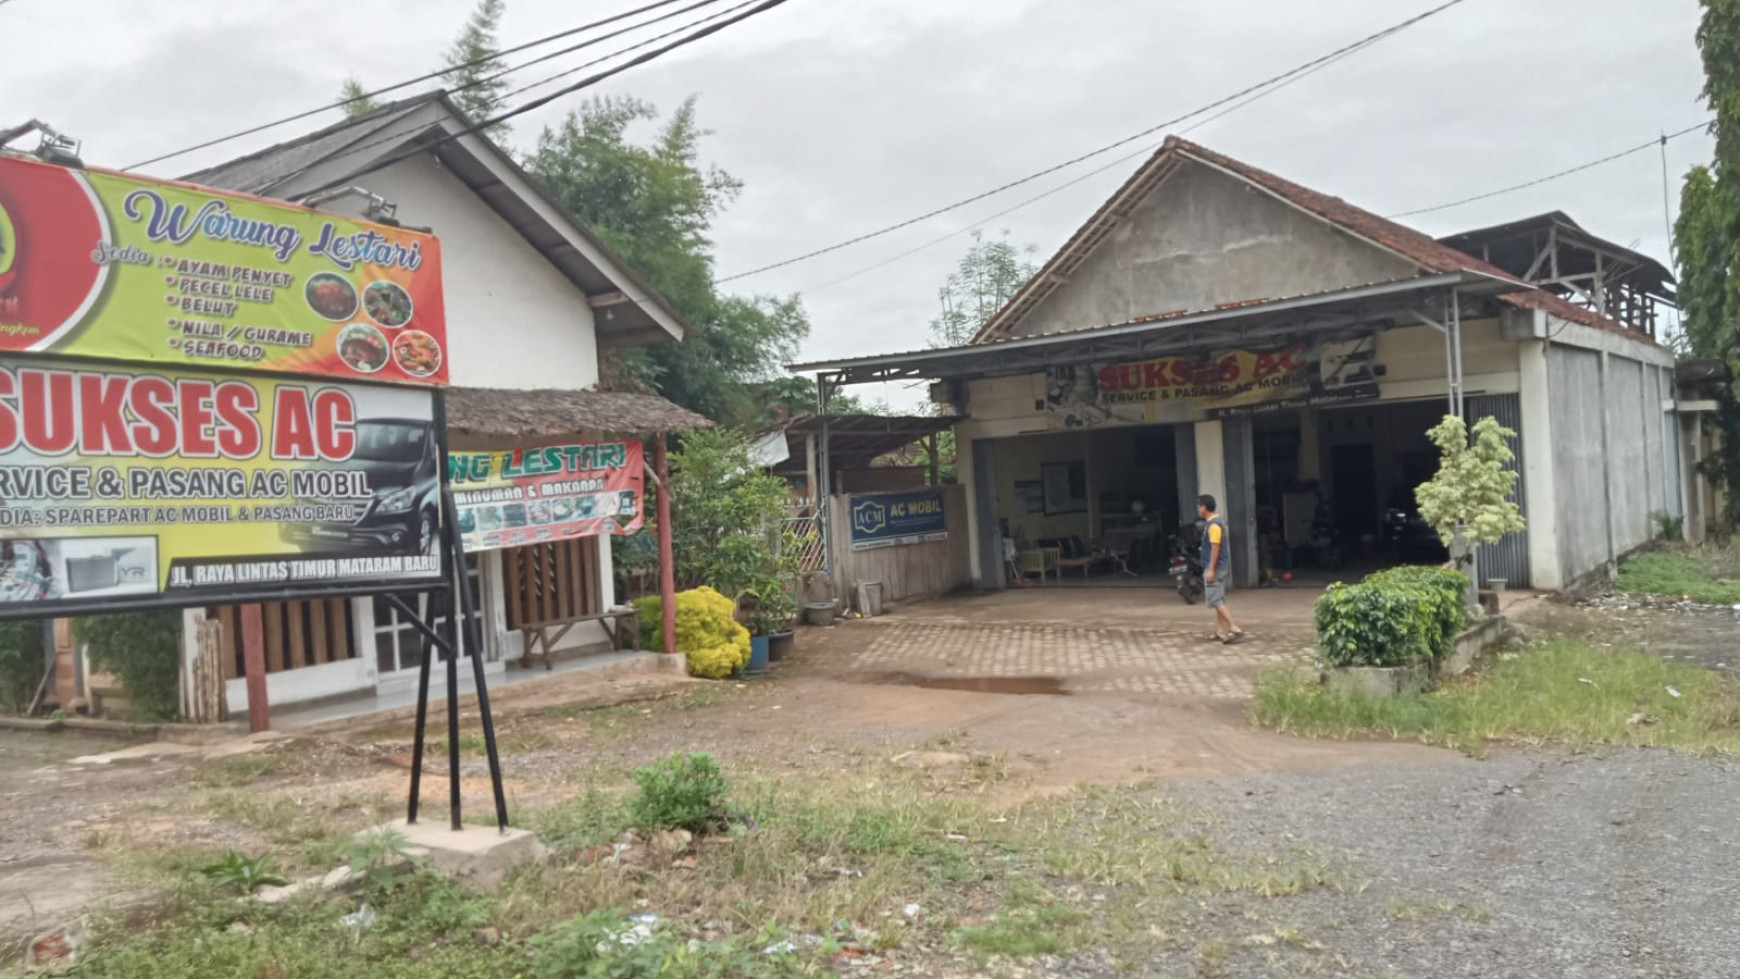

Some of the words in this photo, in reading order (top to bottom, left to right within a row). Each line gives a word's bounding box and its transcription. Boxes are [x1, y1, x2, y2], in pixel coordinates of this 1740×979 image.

[124, 188, 300, 262] Warung
[309, 222, 422, 271] Lestari
[90, 240, 151, 266] Sedia
[178, 259, 229, 278] AYAM
[231, 266, 295, 288] PENYET
[178, 279, 233, 299] PECEL
[234, 284, 273, 302] LELE
[180, 297, 237, 318] BELUT
[182, 320, 222, 340] NILA
[244, 328, 313, 347] GURAME
[183, 340, 264, 361] SEAFOOD
[1252, 342, 1307, 380] AC
[1101, 389, 1157, 405] SERVICE
[1160, 388, 1170, 400] &
[270, 385, 357, 461] AC
[502, 443, 626, 478] LESTARI
[96, 467, 123, 498] &
[129, 467, 244, 500] PASANG
[249, 469, 288, 500] AC
[292, 470, 373, 499] MOBIL
[528, 485, 535, 496] &
[542, 479, 604, 495] MAKANAN
[45, 506, 150, 525] SPAREPART
[153, 506, 178, 523] AC
[180, 505, 234, 523] MOBIL
[237, 505, 250, 522] &
[253, 505, 314, 522] PASANG
[315, 504, 354, 521] BARU
[858, 510, 882, 524] ACM
[890, 503, 905, 516] AC
[908, 499, 941, 515] MOBIL
[196, 565, 234, 583] RAYA
[238, 562, 288, 581] LINTAS
[290, 557, 337, 579] TIMUR
[338, 556, 403, 576] MATARAM
[404, 553, 439, 573] BARU
